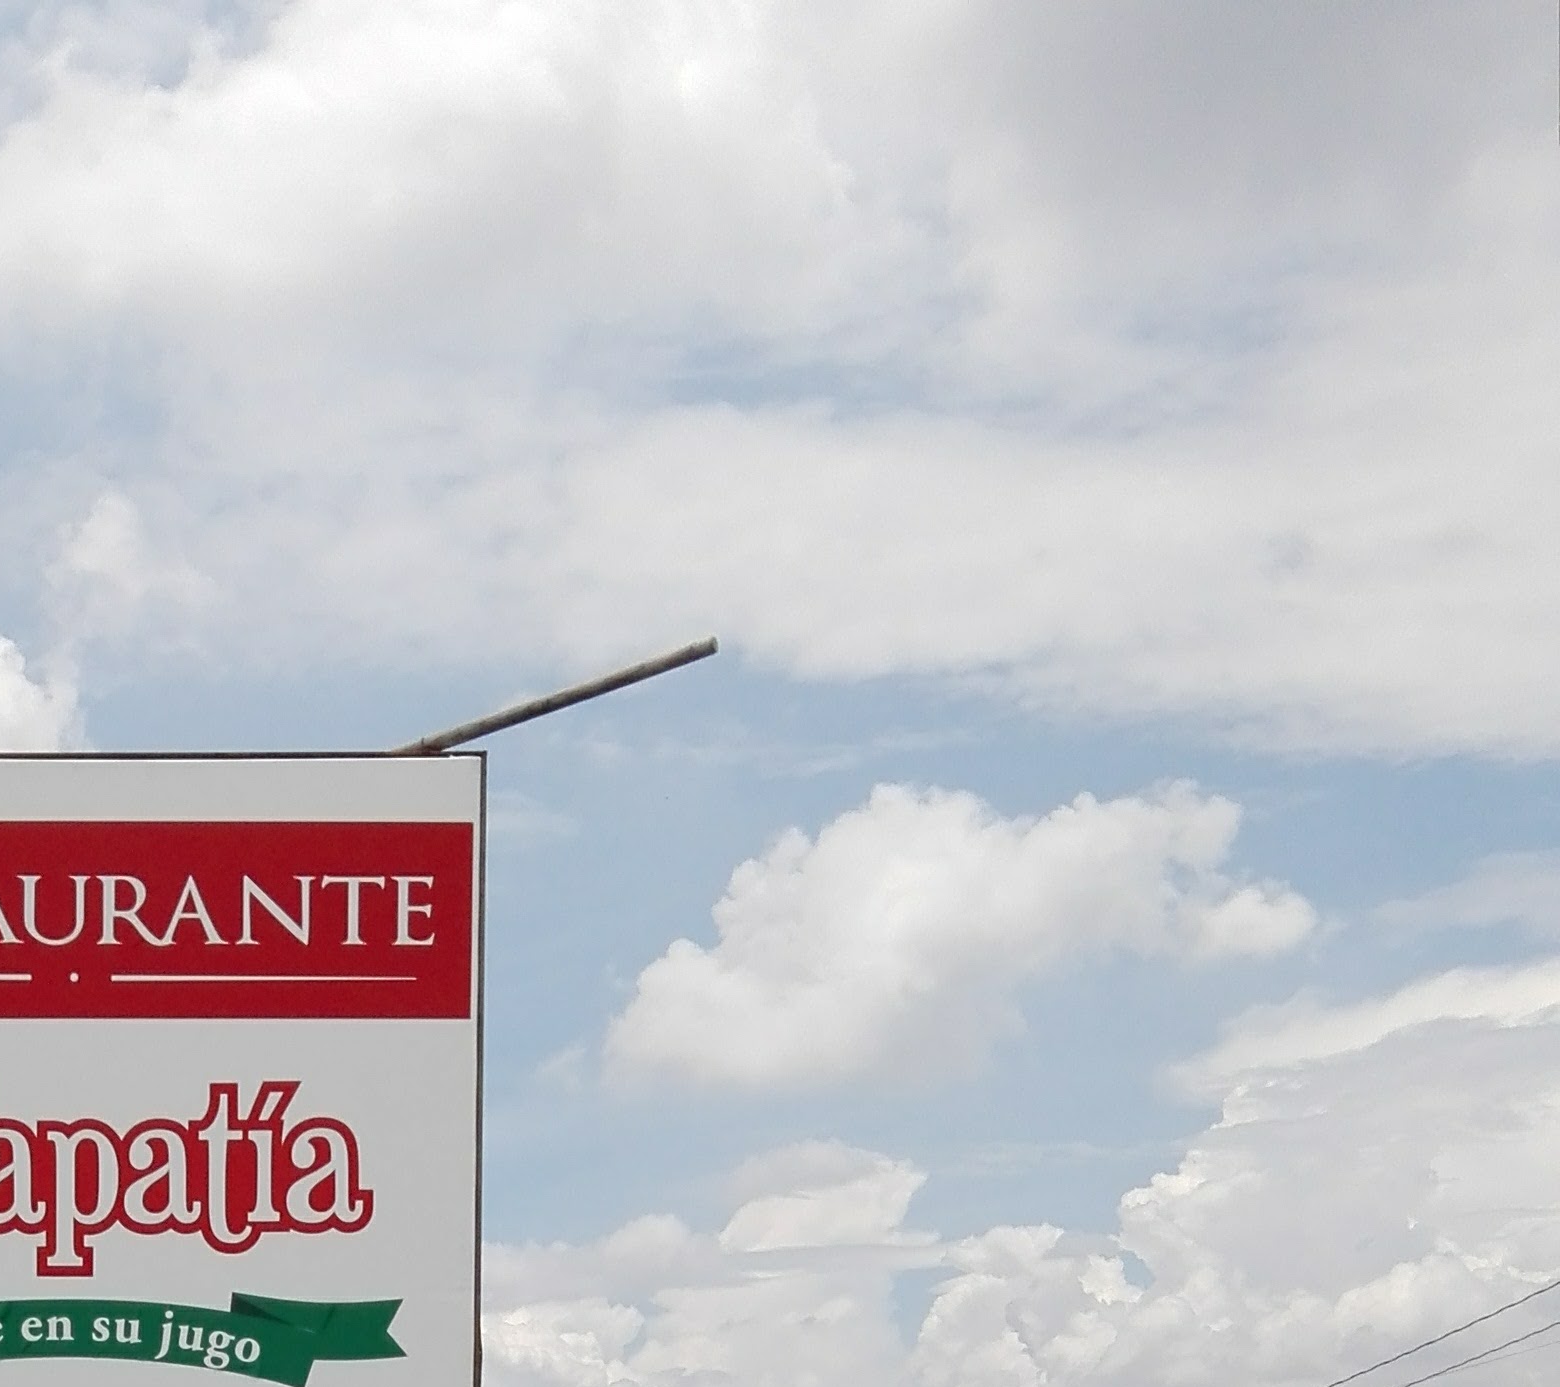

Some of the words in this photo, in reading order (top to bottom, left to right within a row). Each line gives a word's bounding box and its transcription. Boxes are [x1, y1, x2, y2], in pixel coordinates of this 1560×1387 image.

[20, 1315, 75, 1343] en
[91, 1316, 142, 1344] su
[154, 1310, 261, 1370] jugo
